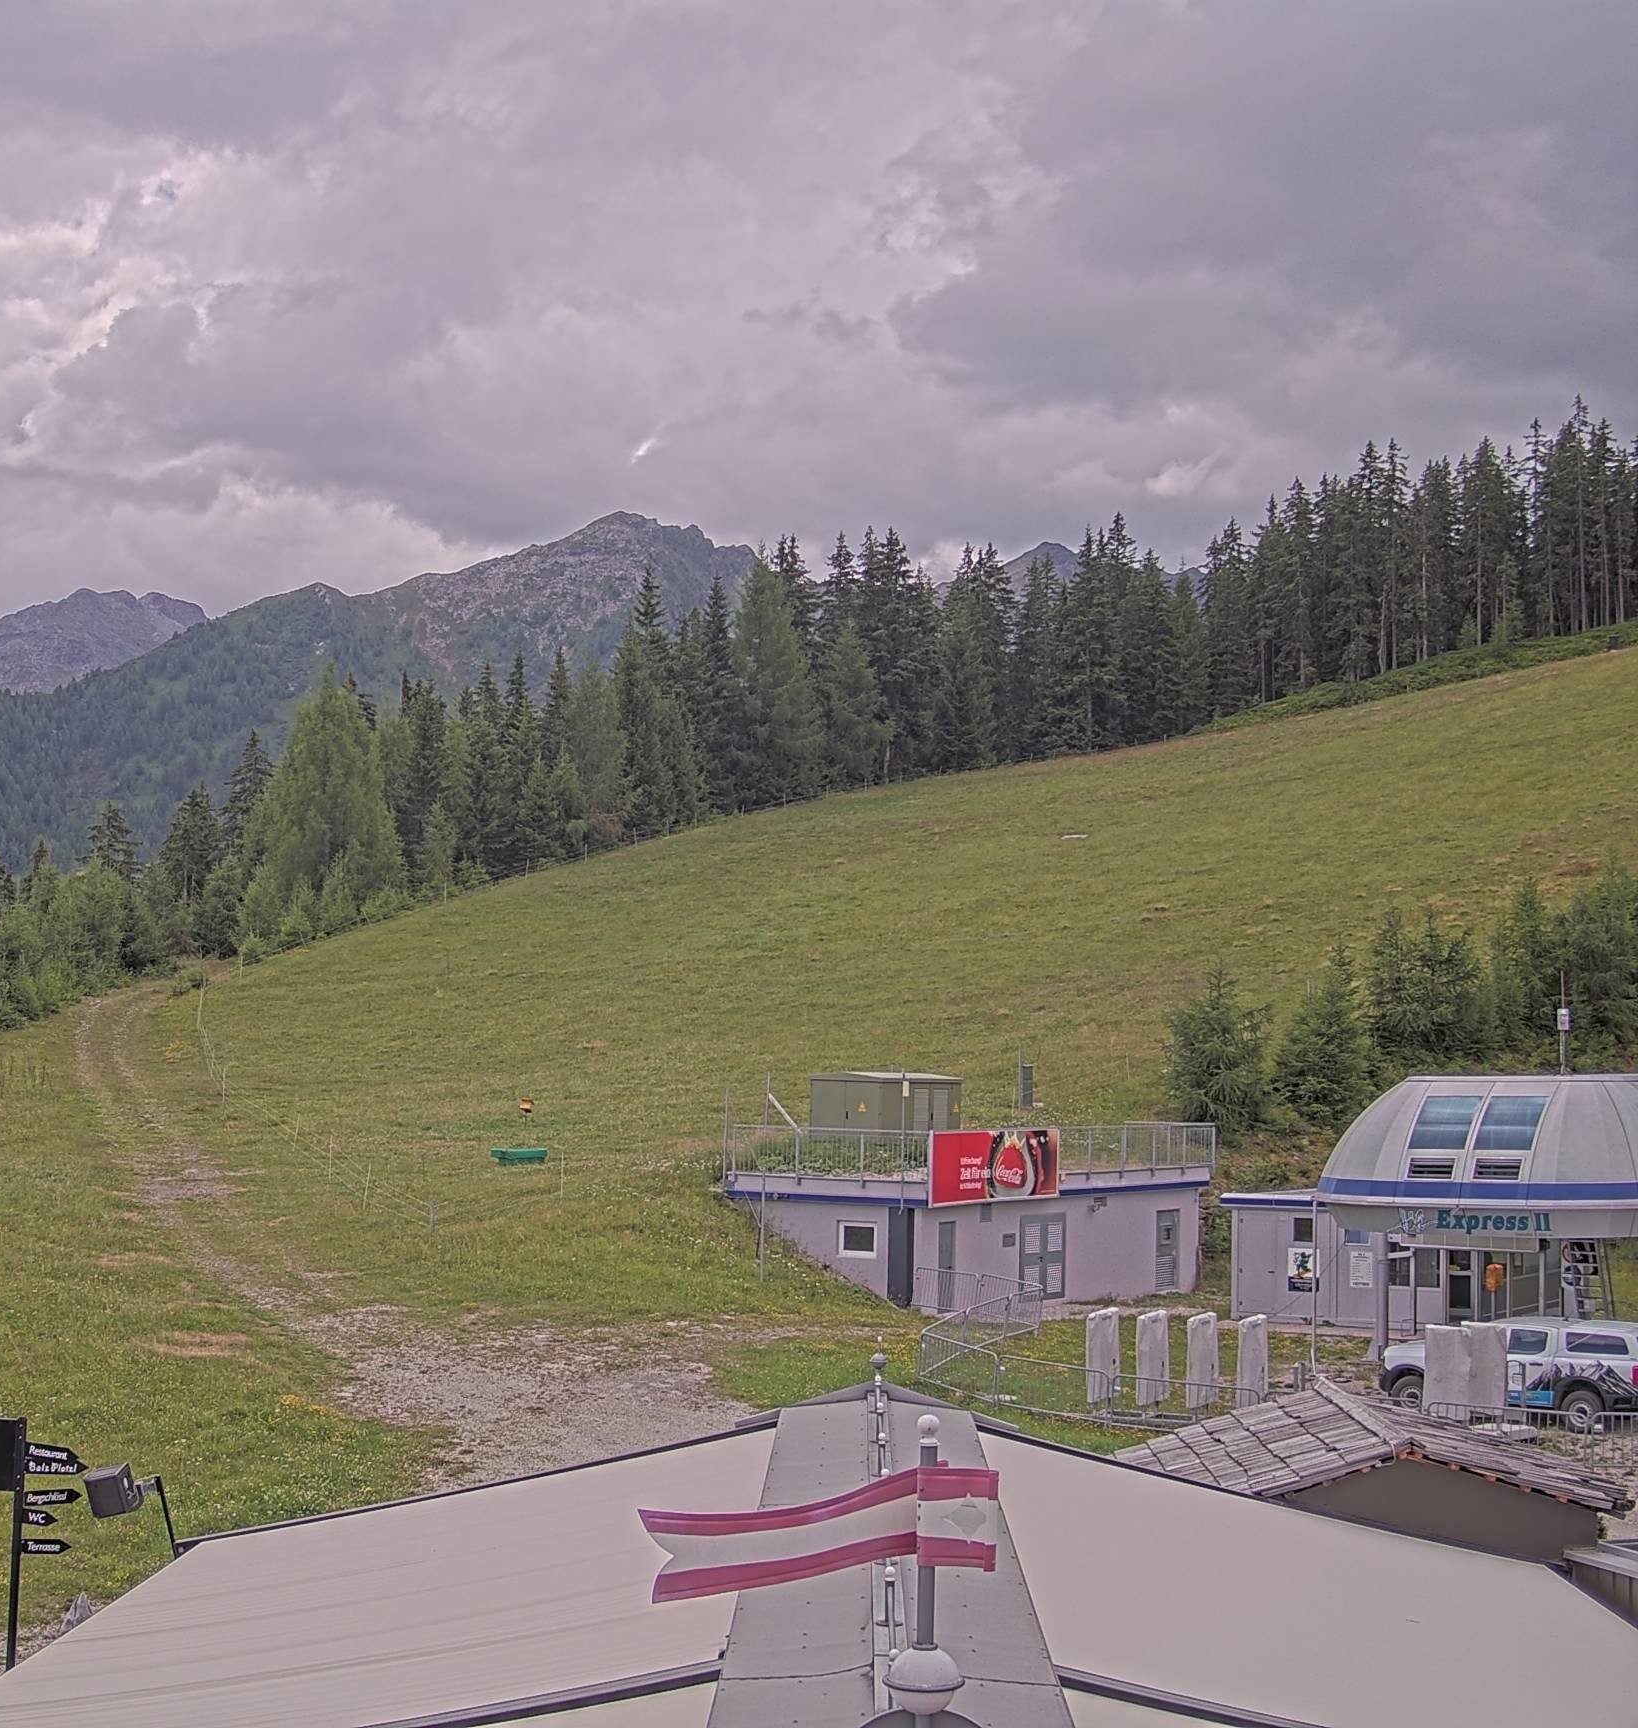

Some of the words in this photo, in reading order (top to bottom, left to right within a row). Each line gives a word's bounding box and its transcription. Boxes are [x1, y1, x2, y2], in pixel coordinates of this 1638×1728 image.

[1436, 1209, 1530, 1234] Express
[1534, 1212, 1551, 1232] II
[29, 1445, 67, 1460] Restaurant
[29, 1512, 46, 1523] WC
[27, 1541, 61, 1552] Terrasse
